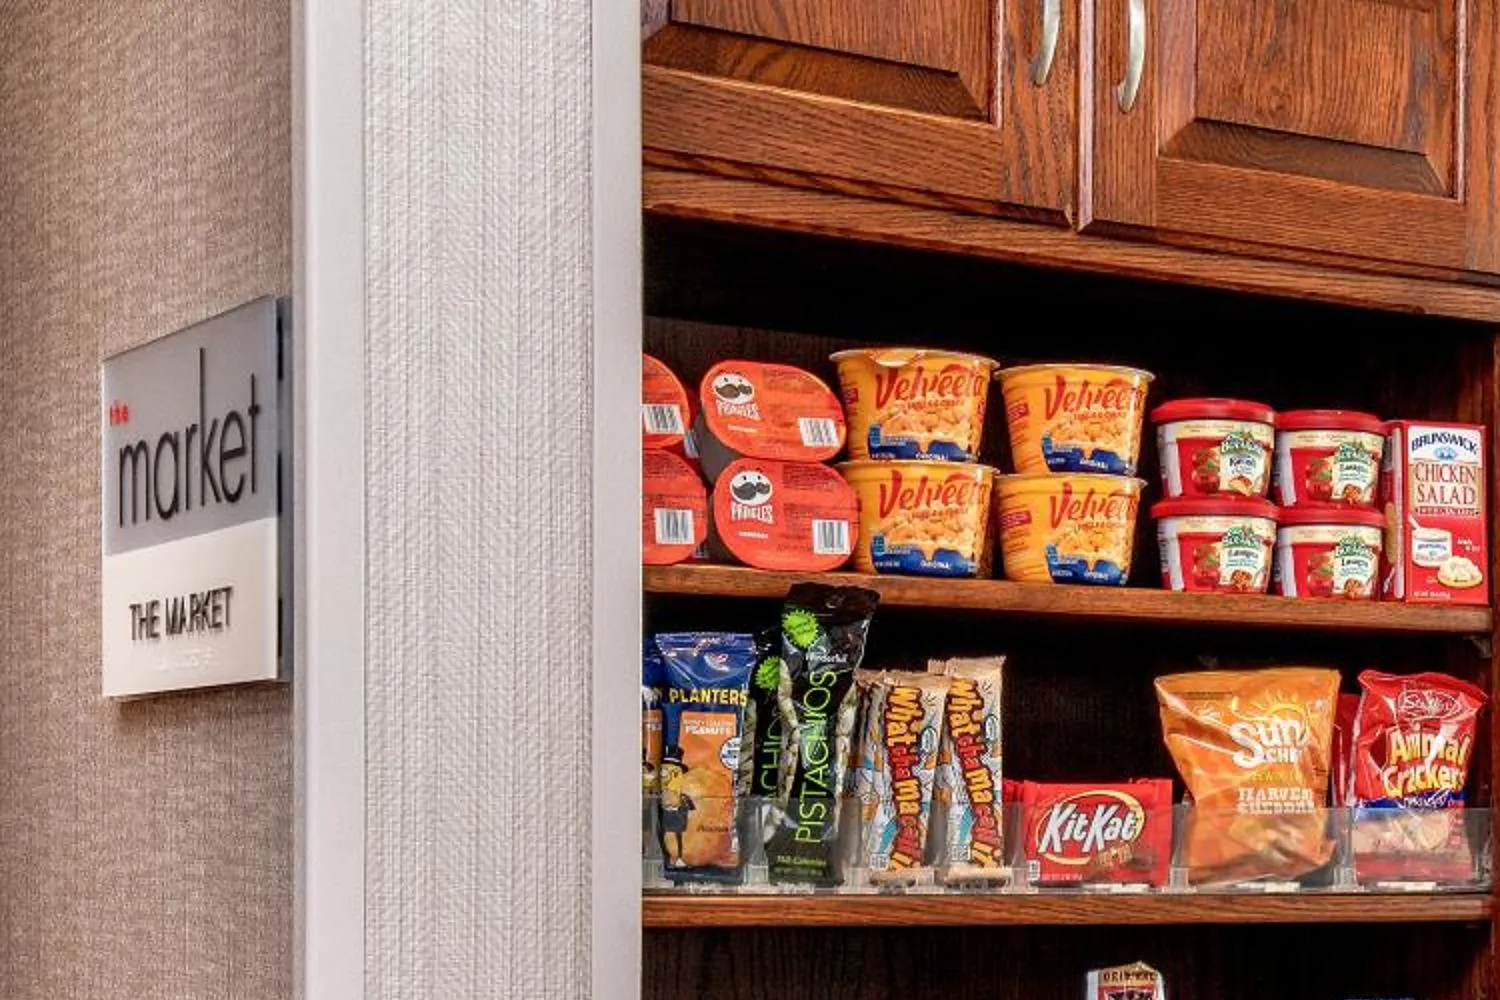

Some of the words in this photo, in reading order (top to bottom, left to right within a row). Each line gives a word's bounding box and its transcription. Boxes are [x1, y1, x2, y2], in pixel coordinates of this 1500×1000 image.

[119, 347, 260, 528] market
[1411, 430, 1477, 454] BRUNSWICK
[1414, 462, 1477, 485] CHICKEN
[1417, 484, 1477, 505] SALAD
[130, 600, 160, 641] THE
[165, 587, 234, 637] MARKET
[668, 687, 748, 707] PLANTERS
[795, 671, 837, 844] PISTACHIOS
[1230, 718, 1308, 769] Sun
[1384, 763, 1465, 798] Crackers
